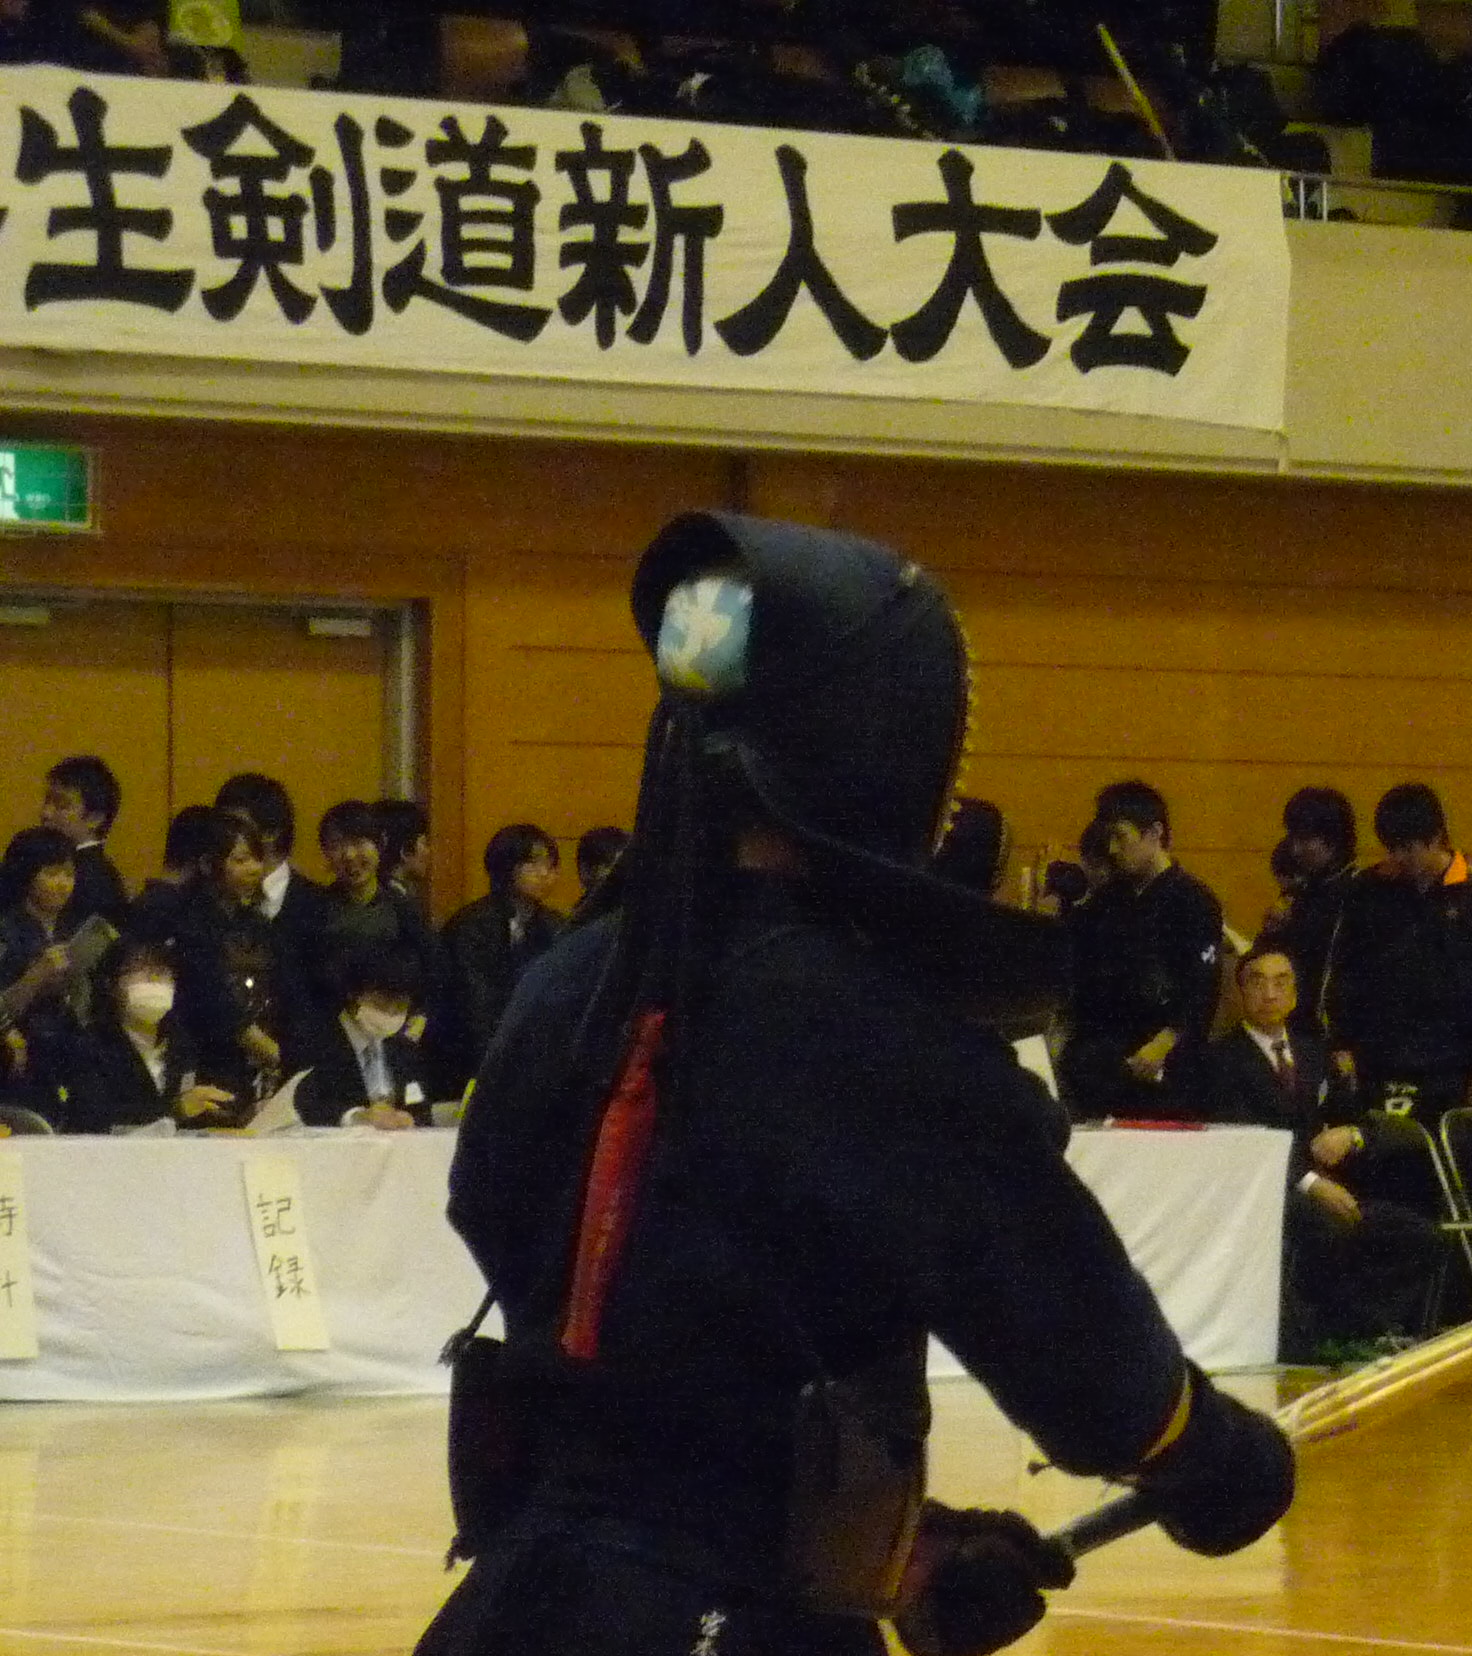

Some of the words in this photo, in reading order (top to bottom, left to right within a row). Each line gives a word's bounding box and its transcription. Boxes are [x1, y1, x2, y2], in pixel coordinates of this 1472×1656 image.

[0, 86, 1217, 377] 生剣道新人大会
[256, 1194, 311, 1299] 記録
